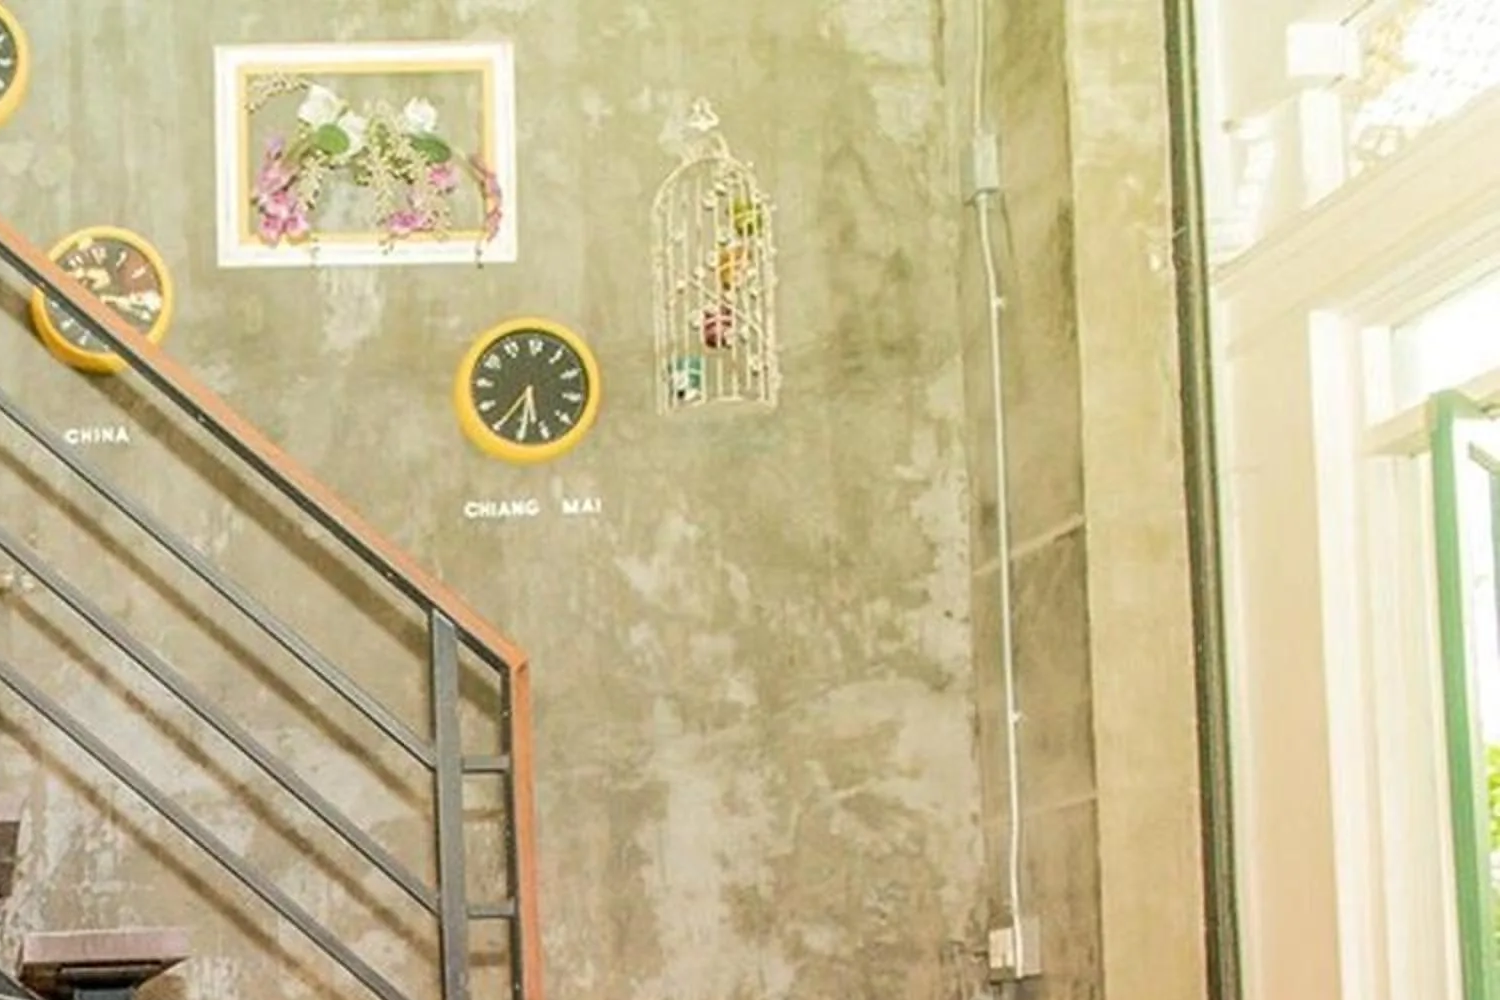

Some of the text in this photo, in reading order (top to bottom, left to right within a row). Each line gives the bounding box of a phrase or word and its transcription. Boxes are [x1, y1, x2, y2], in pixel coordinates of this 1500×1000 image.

[63, 426, 131, 445] CHINA
[464, 497, 603, 519] CHIANG MAI
